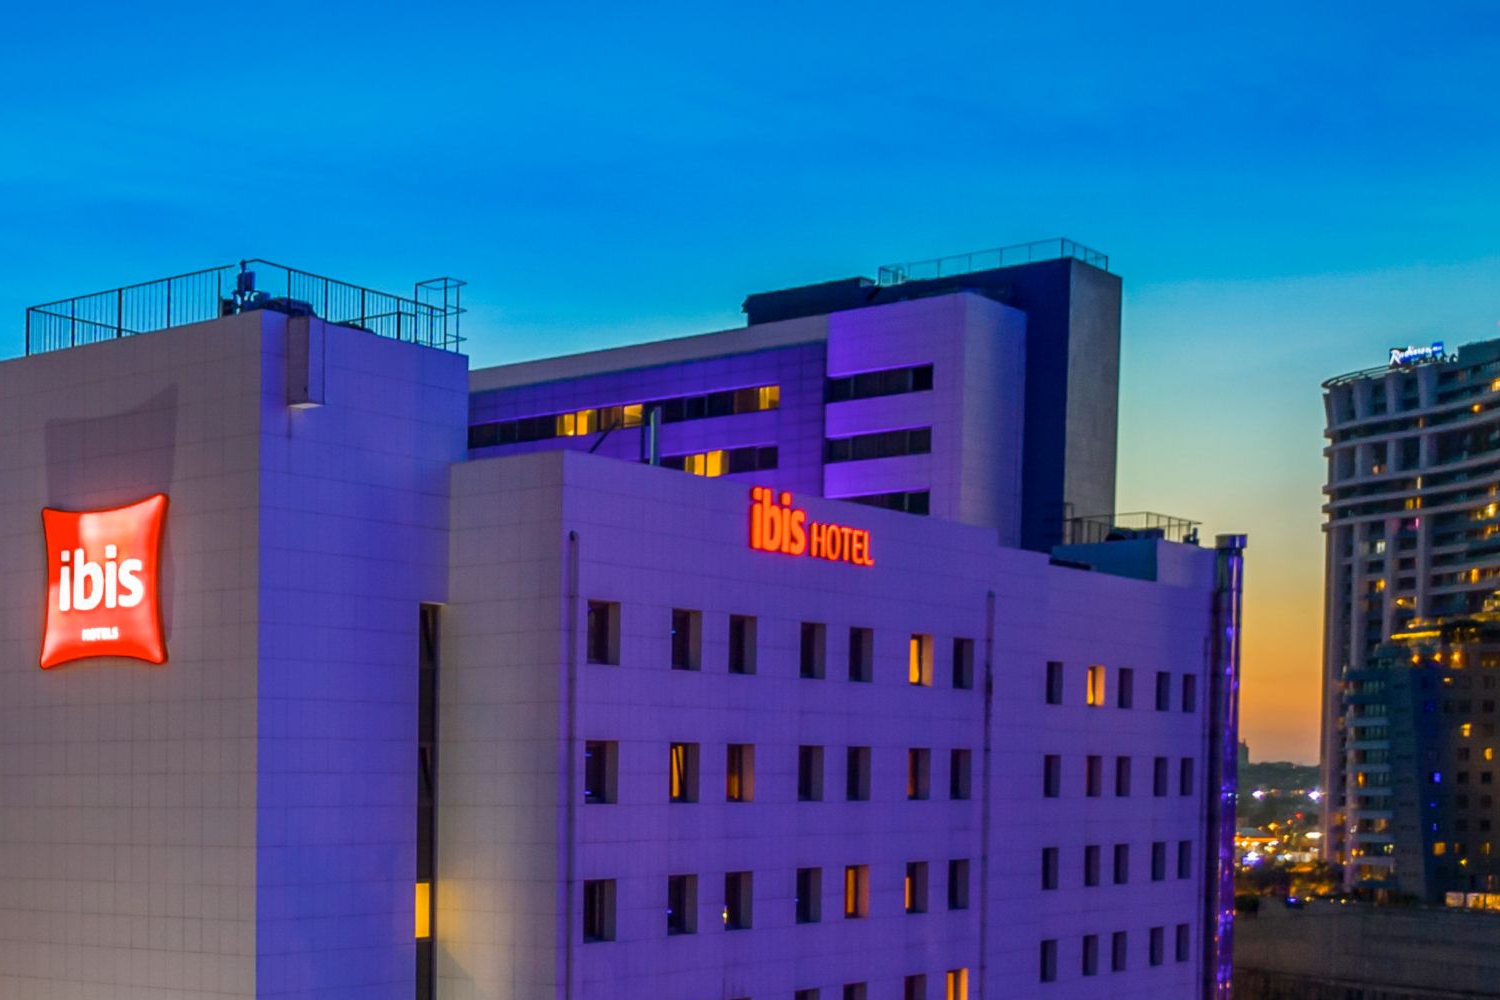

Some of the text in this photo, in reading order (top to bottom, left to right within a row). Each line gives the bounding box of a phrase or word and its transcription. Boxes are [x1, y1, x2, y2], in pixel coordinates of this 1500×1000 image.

[750, 485, 875, 567] ibis HOTEL
[59, 544, 145, 611] ibis
